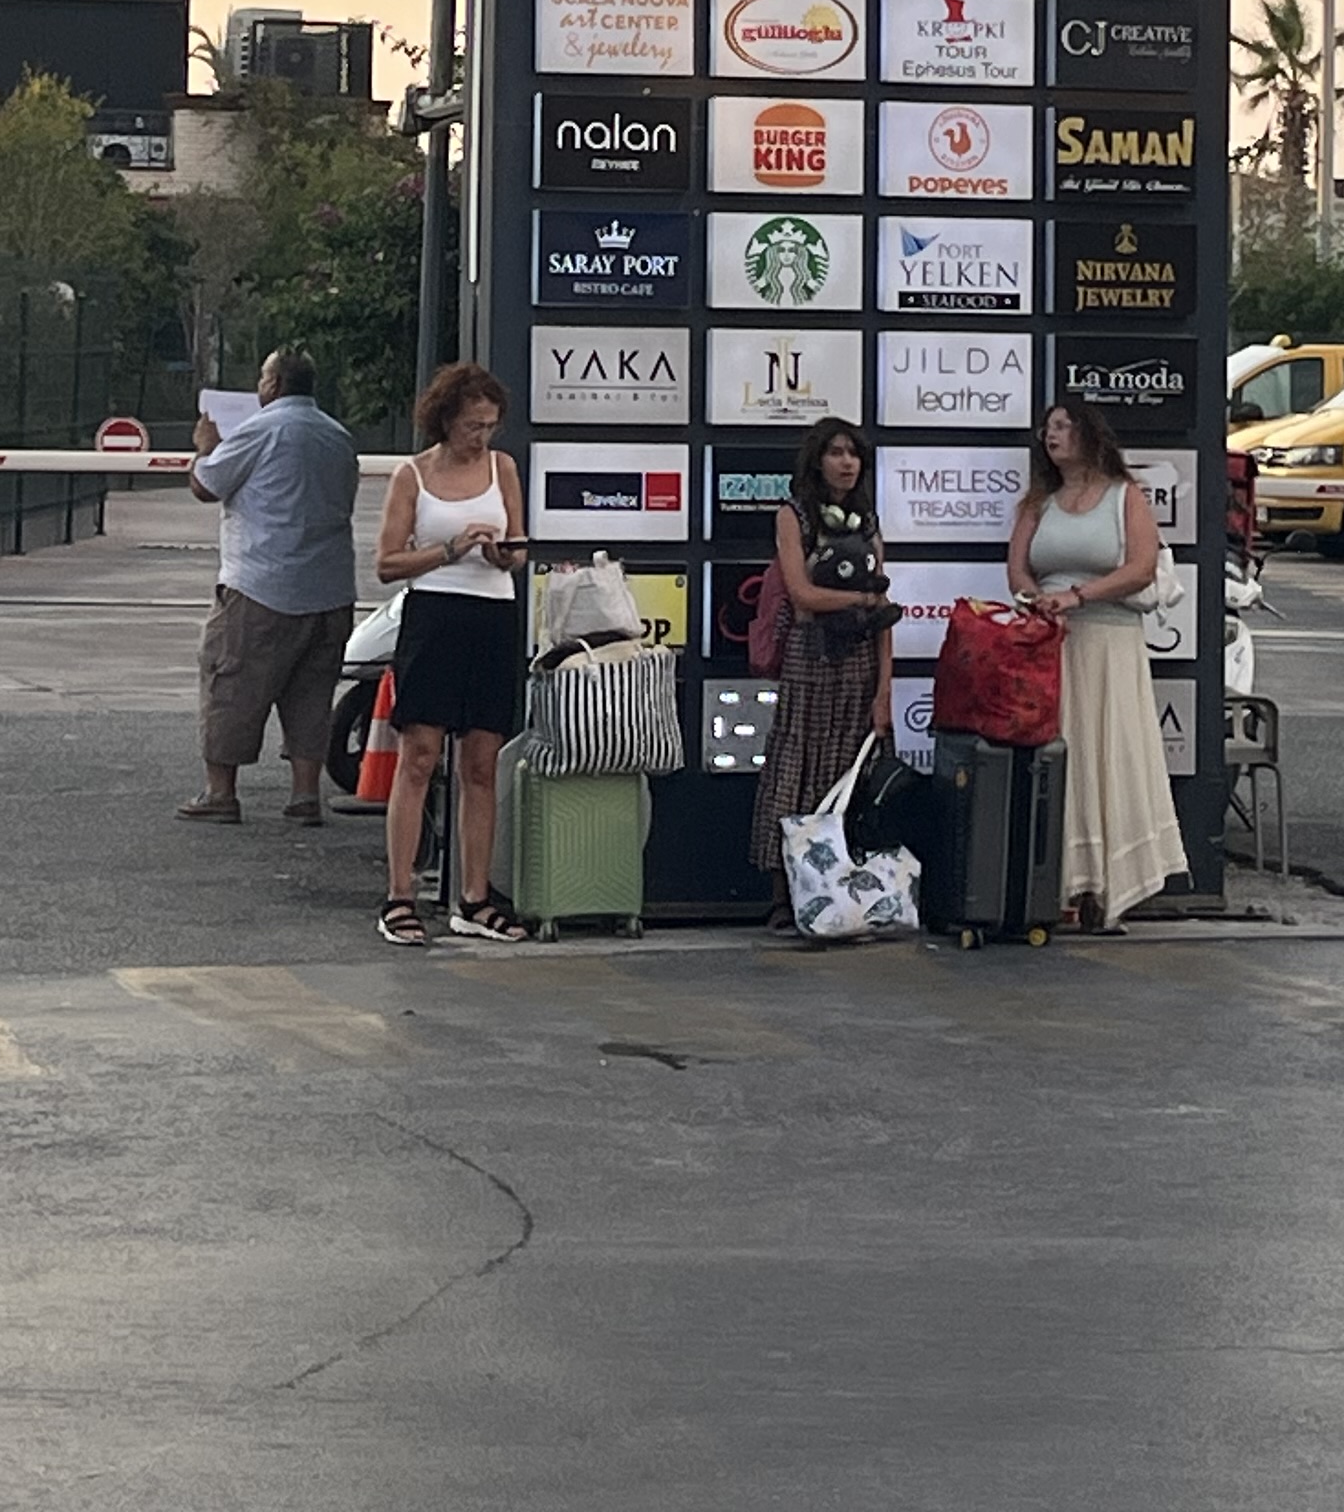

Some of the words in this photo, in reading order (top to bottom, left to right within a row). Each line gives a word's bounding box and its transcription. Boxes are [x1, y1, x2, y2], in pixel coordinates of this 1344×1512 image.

[1110, 24, 1193, 43] CREATIVE
[935, 45, 988, 60] TOUR
[902, 60, 976, 79] Ephesus
[982, 61, 1018, 79] Tour
[556, 112, 676, 152] nalan
[753, 129, 826, 147] BURGER
[753, 148, 826, 171] KING
[938, 242, 983, 260] PORT
[548, 252, 615, 276] SARAY
[623, 255, 679, 277] PORT
[899, 259, 1019, 288] YELKEN
[1076, 259, 1176, 282] NIRVANA
[921, 294, 997, 309] SEAFOOD
[1075, 287, 1175, 313] JEWELRY
[892, 347, 1024, 375] JILDA
[1066, 364, 1101, 388] La
[1109, 367, 1185, 390] moda
[916, 385, 1013, 414] leather
[894, 469, 1021, 494] TIMELESS
